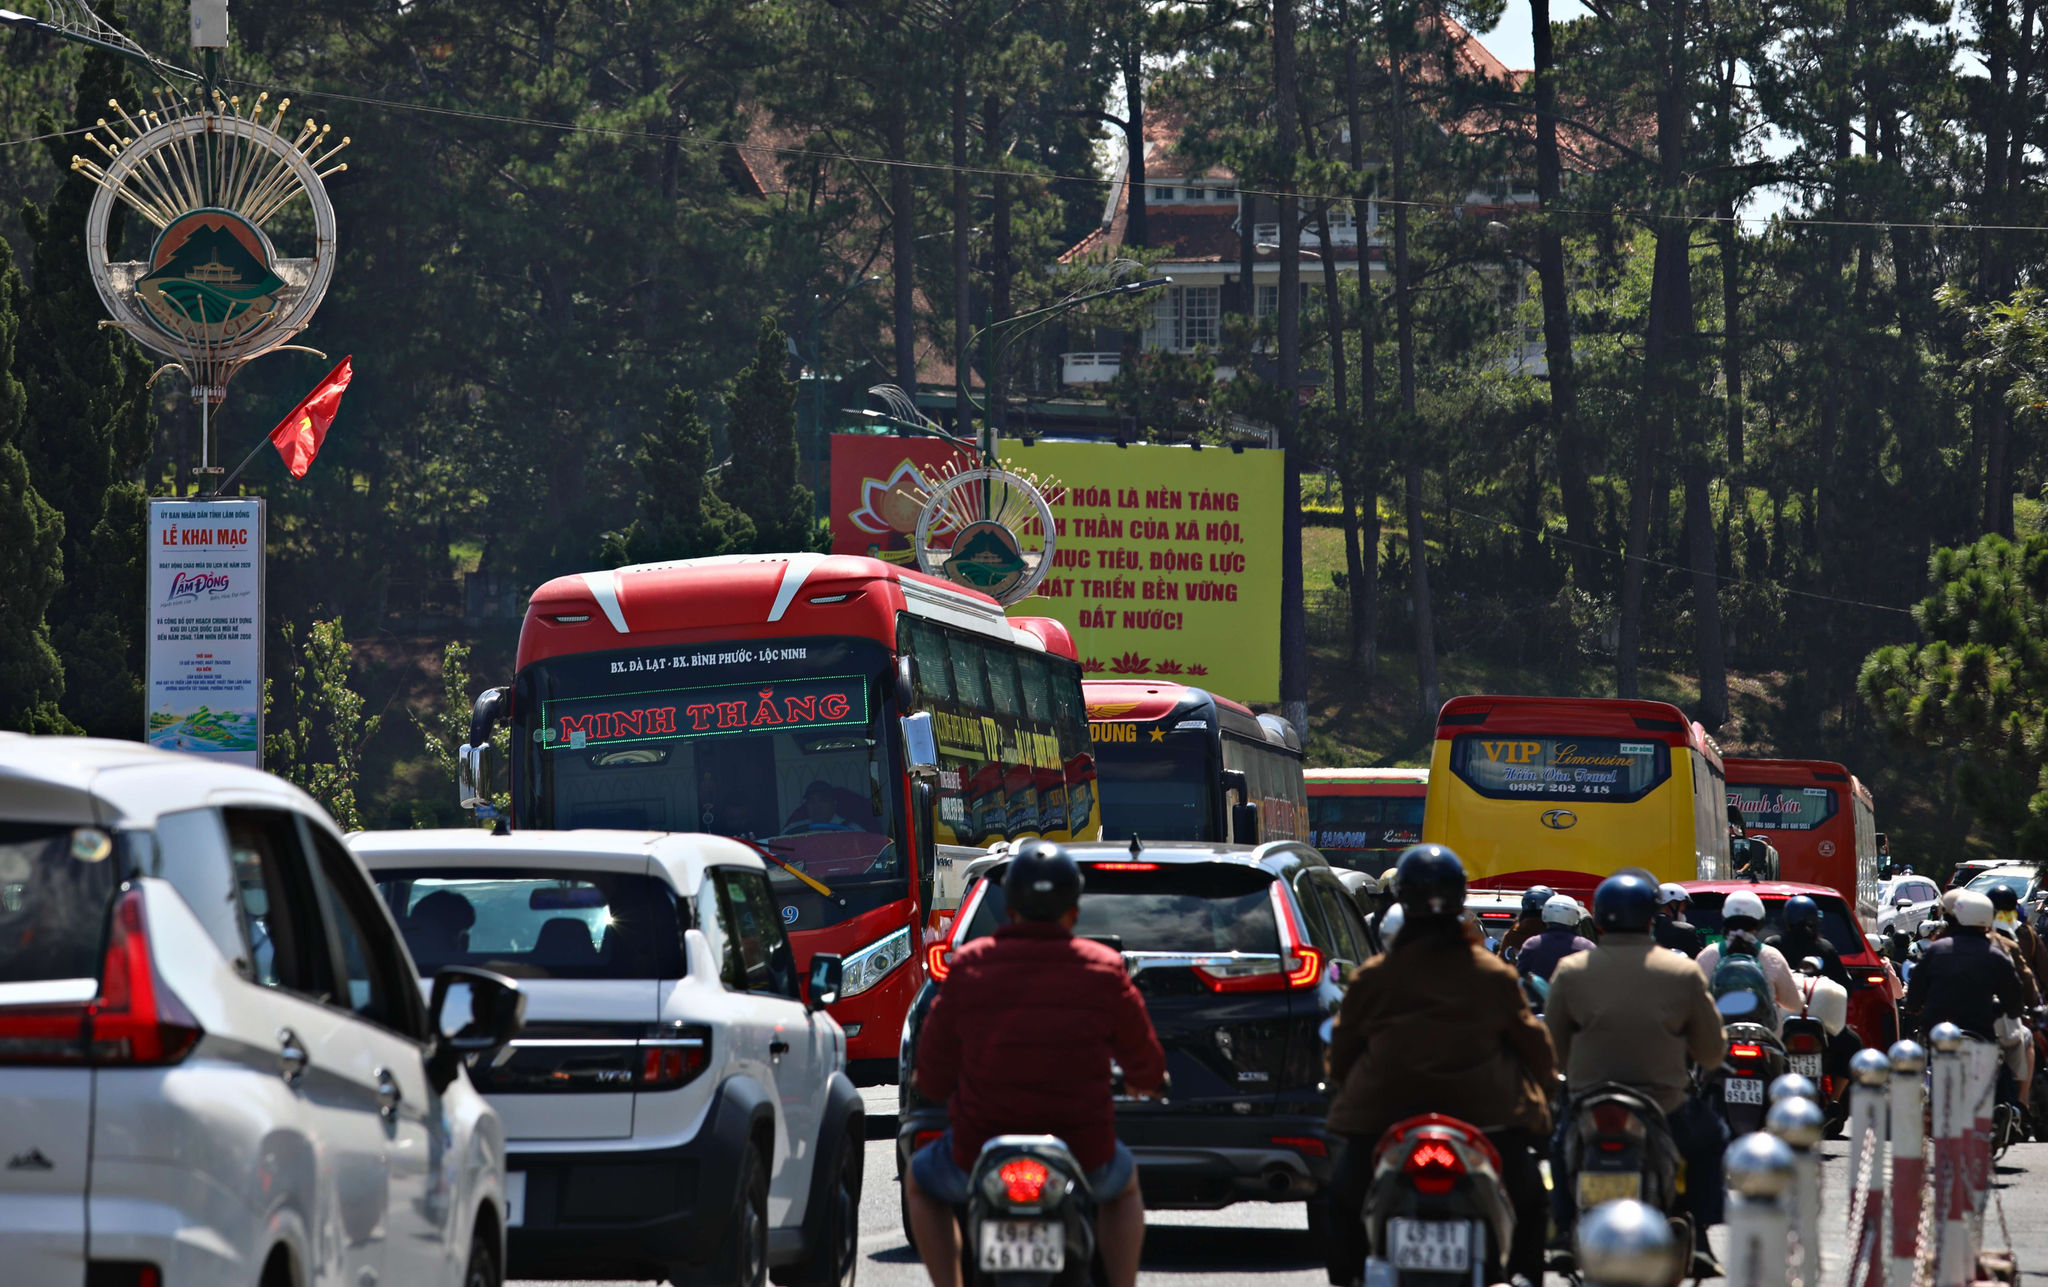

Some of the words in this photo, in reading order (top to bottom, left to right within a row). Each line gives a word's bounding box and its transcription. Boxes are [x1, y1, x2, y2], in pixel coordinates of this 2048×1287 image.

[1073, 485, 1111, 507] HÓA
[1118, 486, 1139, 508] LÀ
[1146, 485, 1182, 510] NỀN
[1188, 488, 1239, 512] TẢNG
[169, 511, 180, 519] BAN
[181, 510, 196, 519] NHÂN
[197, 510, 208, 519] DÂN
[223, 509, 234, 518] LÂM
[163, 523, 178, 545] LỄ
[182, 529, 213, 545] KHAI
[217, 529, 248, 549] MẠC
[1073, 513, 1123, 538] THẦN
[1130, 516, 1169, 540] CỦA
[1175, 519, 1200, 541] XÃ
[1206, 520, 1244, 545] HỘI,
[1052, 549, 1090, 571] MỤC
[1097, 547, 1143, 571] TIÊU,
[1150, 548, 1203, 574] ĐỘNG
[1210, 551, 1246, 576] LỰC
[1081, 574, 1135, 599] TRIỂN
[1142, 575, 1178, 600] BỀN
[1185, 580, 1238, 602] VỮNG
[1079, 604, 1116, 629] ĐẤT
[1123, 608, 1183, 630] NƯỚC!
[610, 662, 627, 673] BX.
[629, 656, 644, 672] ĐÀ
[646, 658, 666, 672] LẠT
[673, 656, 689, 668] BX.
[691, 652, 716, 667] BÌNH
[718, 648, 752, 665] PHƯỚC
[759, 647, 779, 664] LỘC
[781, 647, 807, 660] NINH
[560, 707, 677, 742] MINH
[686, 686, 850, 730] THẮNG
[1481, 741, 1542, 763] VIP
[1546, 743, 1636, 767] Limousine
[1509, 783, 1545, 792] 0987
[1549, 784, 1577, 793] 202
[1582, 784, 1610, 794] 418
[1574, 768, 1617, 783] Travel
[1726, 793, 1772, 813] Thanh
[1772, 793, 1802, 814] Sơn
